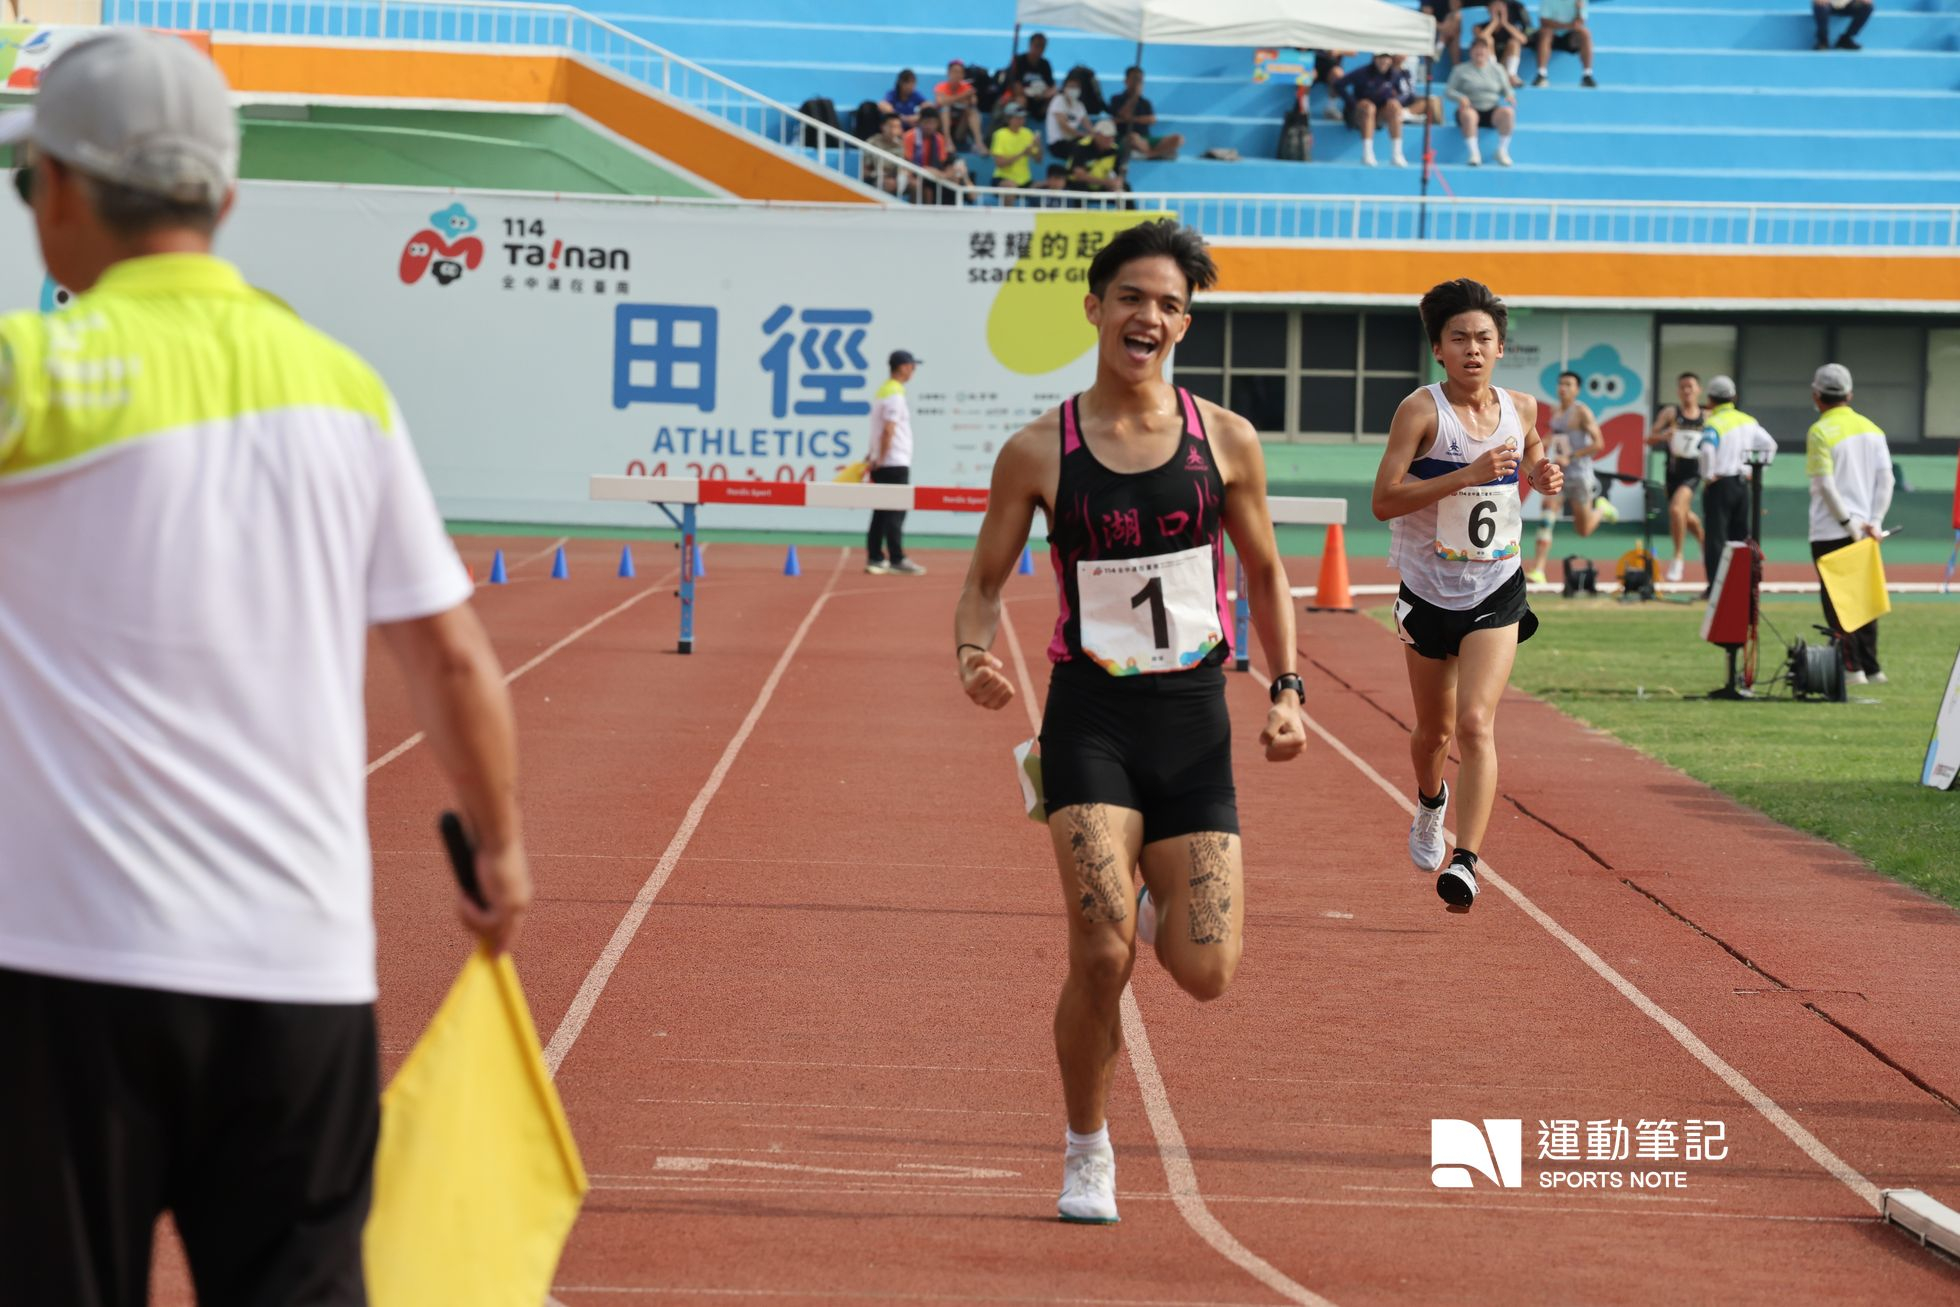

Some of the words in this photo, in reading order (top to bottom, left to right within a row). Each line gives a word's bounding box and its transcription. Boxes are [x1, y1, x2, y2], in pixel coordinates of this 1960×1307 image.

[503, 218, 545, 238] 114
[503, 239, 630, 270] Ta!nan
[970, 231, 1121, 260] 榮耀的起
[613, 303, 873, 419] 田徑
[653, 426, 852, 458] ATHLETICS
[1683, 435, 1694, 453] 7
[1102, 508, 1190, 548] 湖口
[1468, 500, 1498, 549] 6
[1131, 576, 1170, 649] 1
